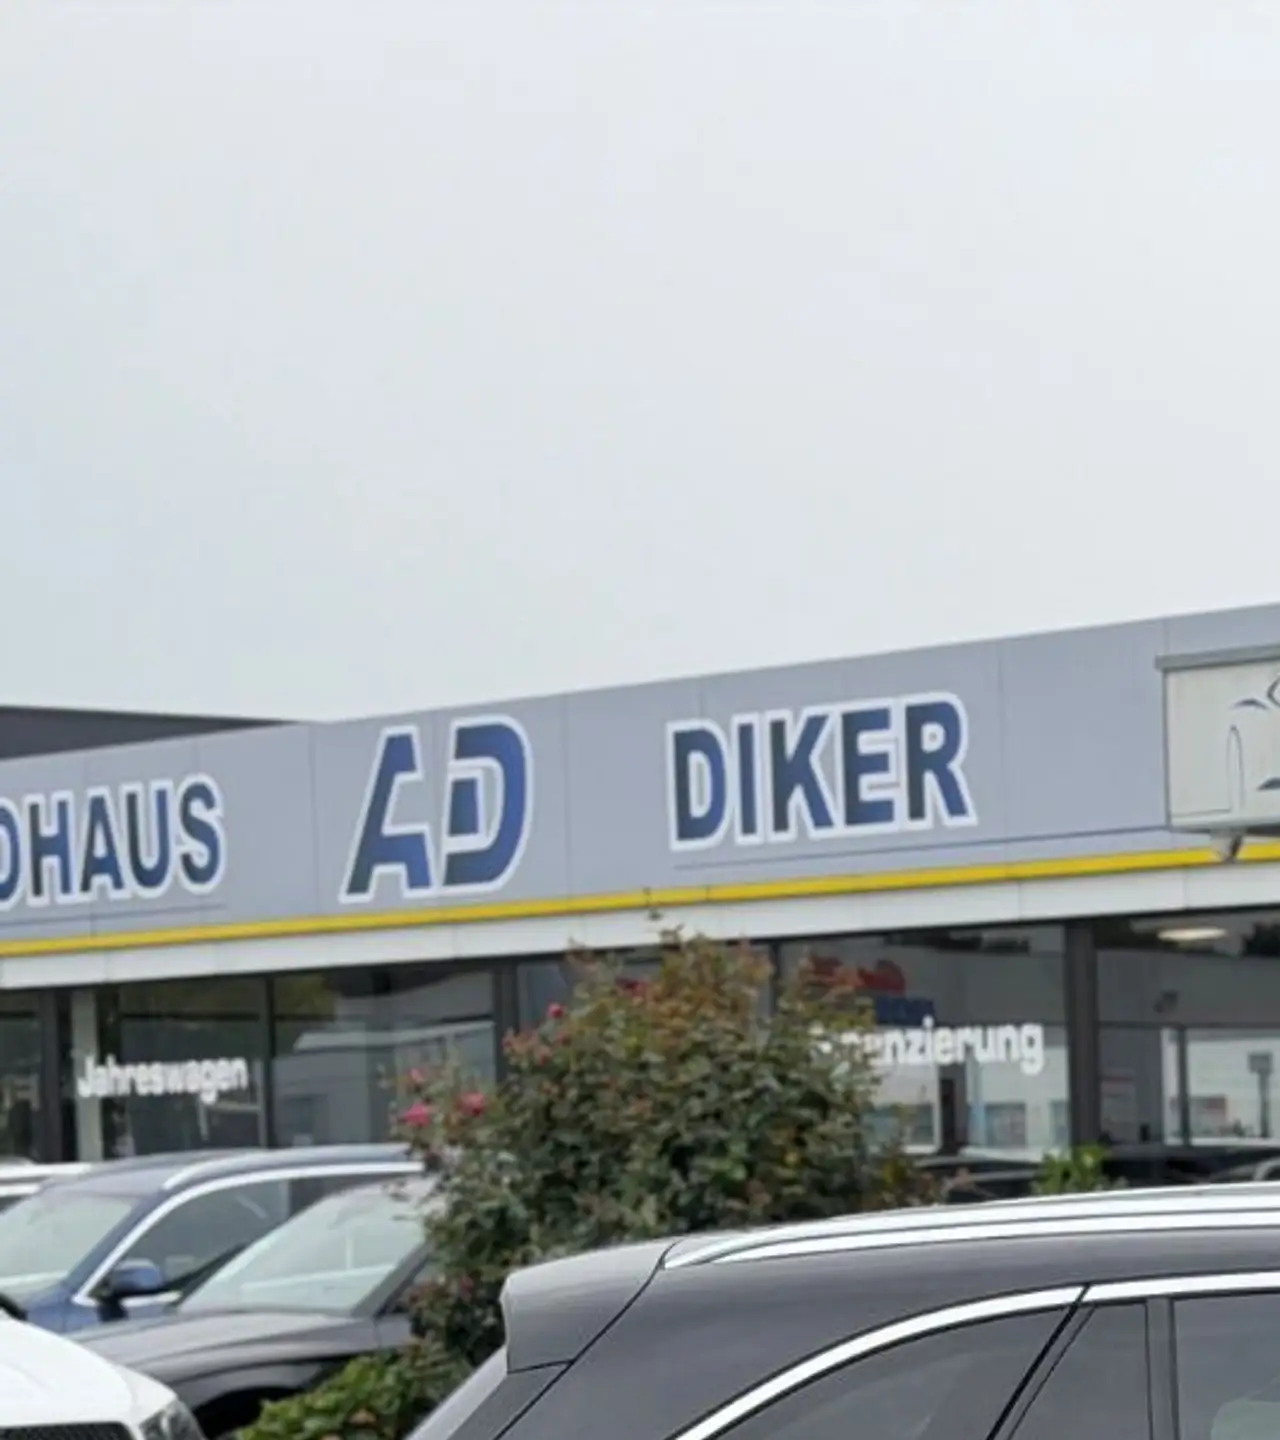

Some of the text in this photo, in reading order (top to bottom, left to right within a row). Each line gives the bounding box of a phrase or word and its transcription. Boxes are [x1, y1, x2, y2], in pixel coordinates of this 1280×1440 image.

[338, 714, 533, 903] AD
[667, 692, 977, 850] DIKER
[77, 1052, 248, 1105] Jahreswagen
